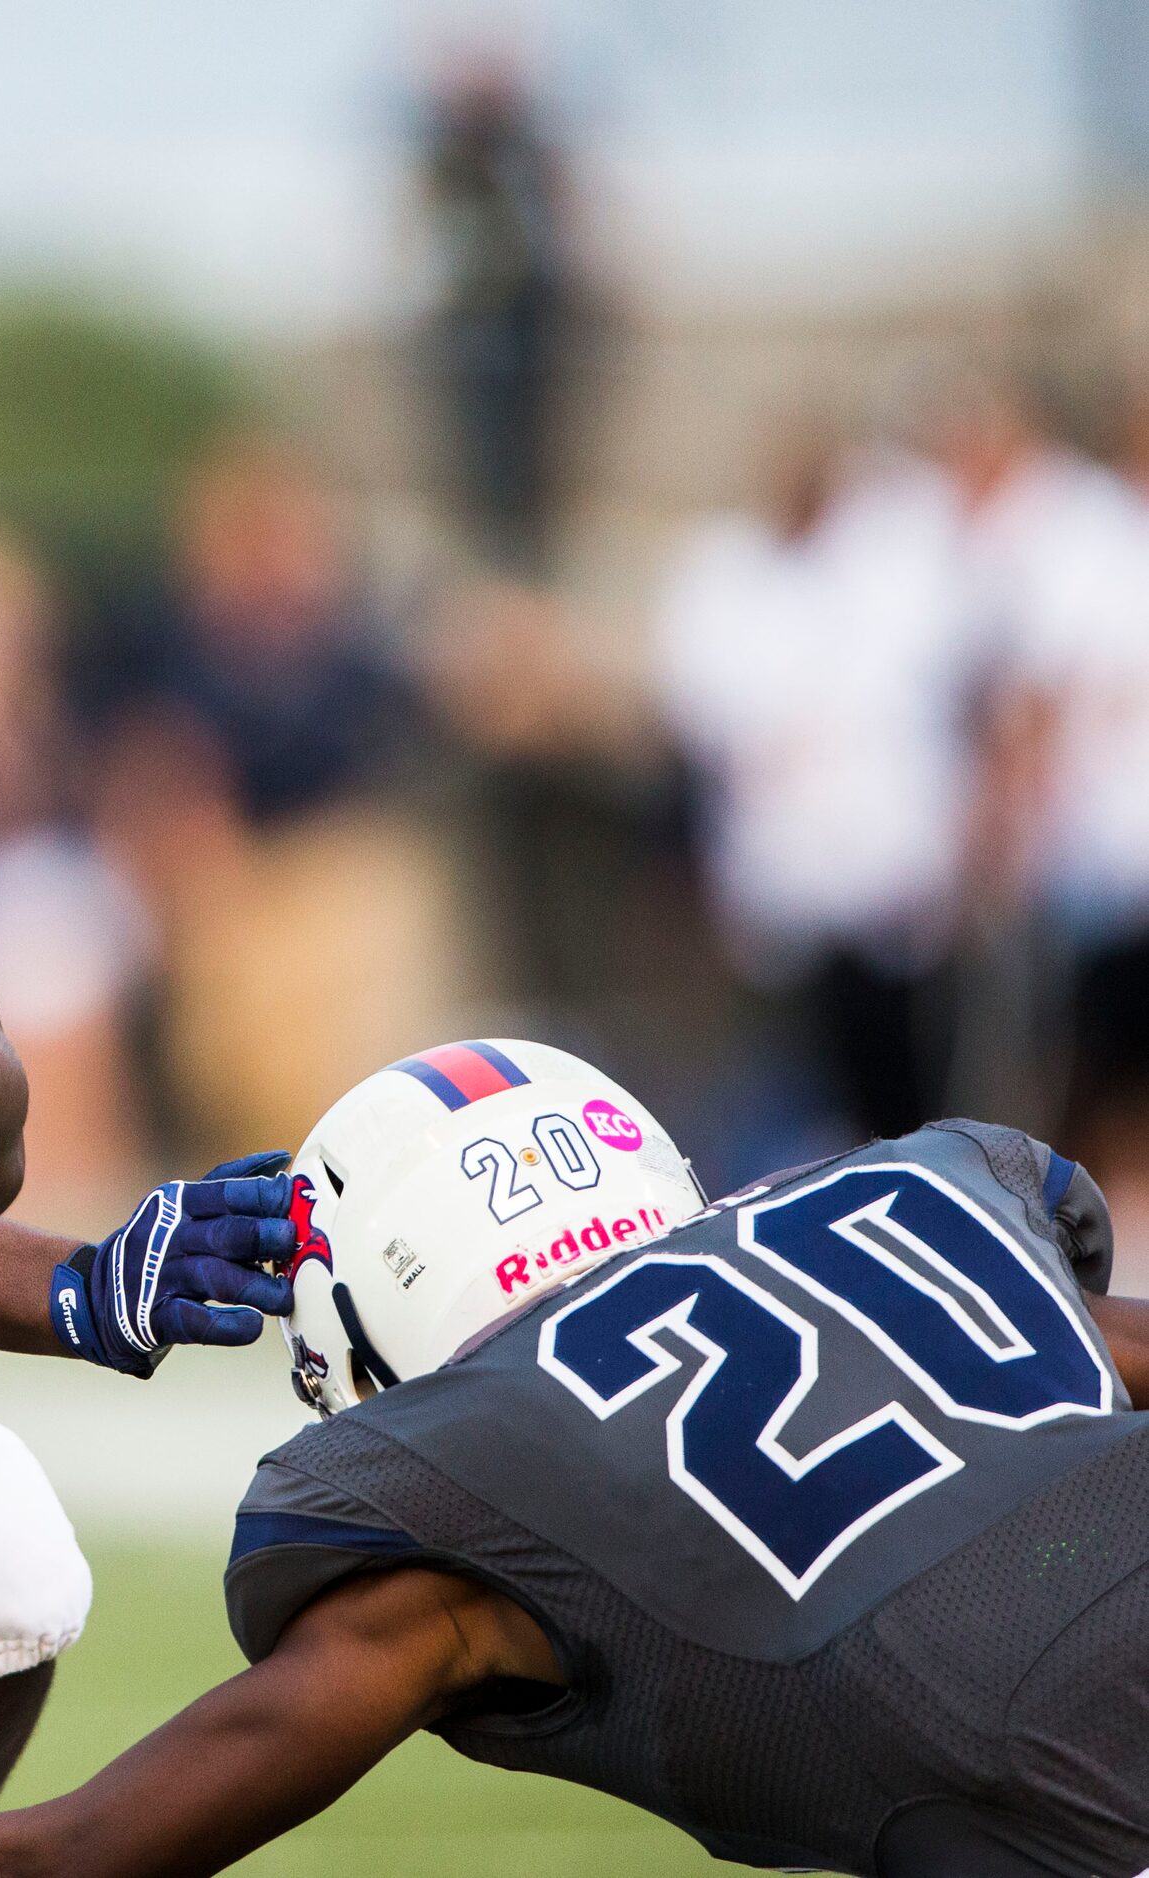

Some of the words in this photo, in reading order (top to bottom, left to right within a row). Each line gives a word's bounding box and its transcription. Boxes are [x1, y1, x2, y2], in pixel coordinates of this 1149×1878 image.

[585, 1111, 638, 1139] KC
[460, 1113, 601, 1225] 20
[402, 1263, 427, 1290] SMALL
[58, 1287, 81, 1345] CUTTERS
[537, 1162, 1113, 1601] 20
